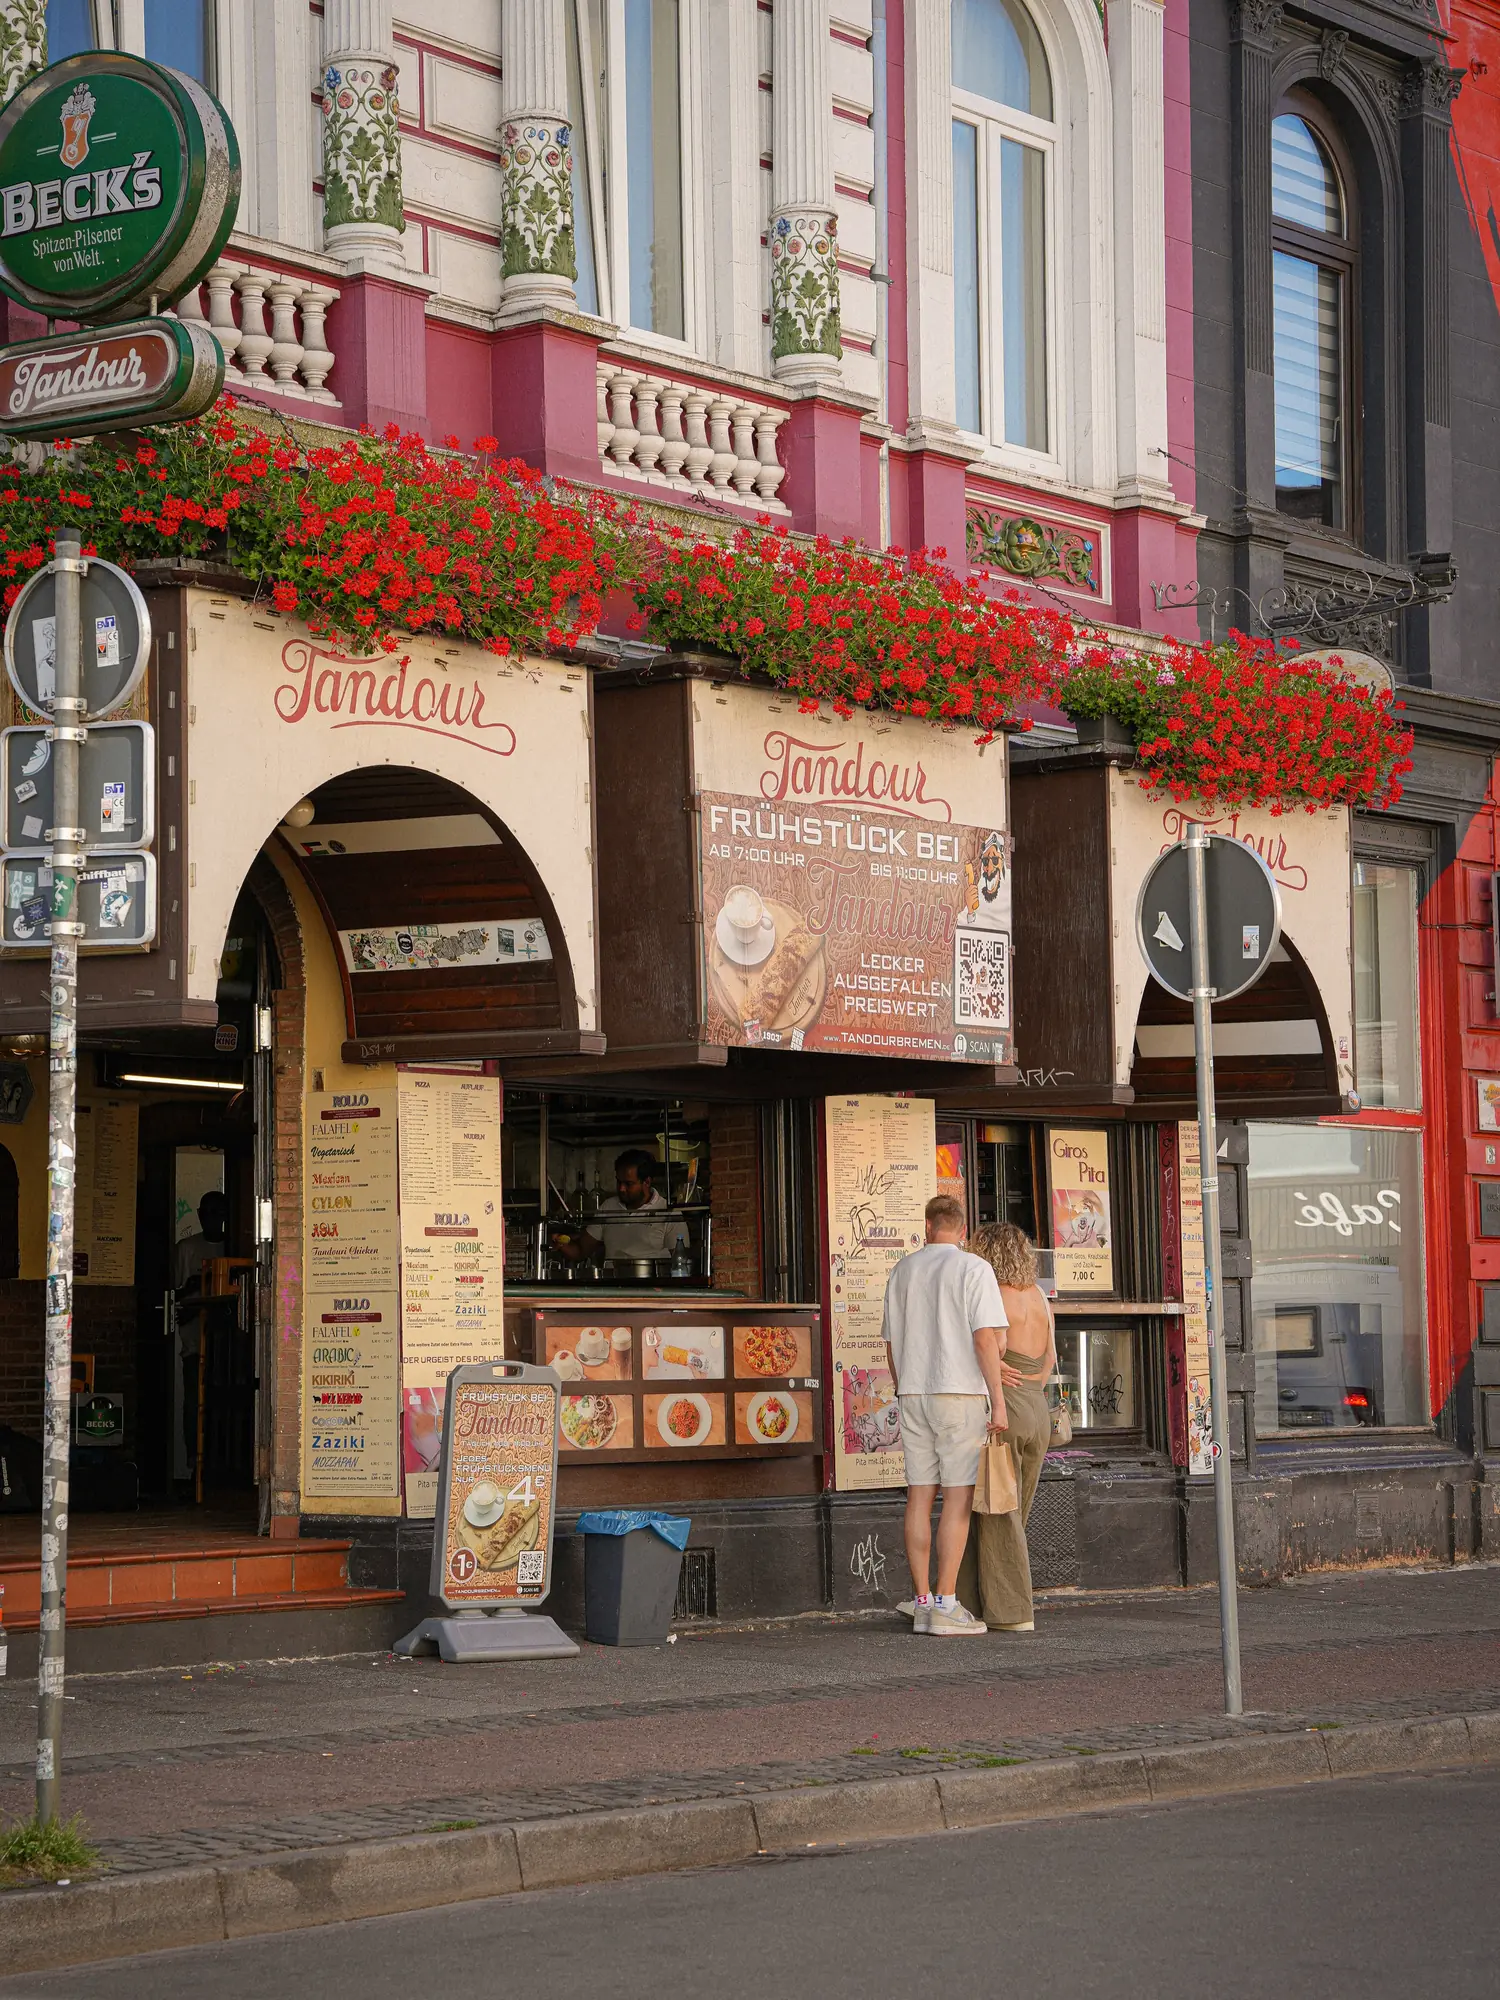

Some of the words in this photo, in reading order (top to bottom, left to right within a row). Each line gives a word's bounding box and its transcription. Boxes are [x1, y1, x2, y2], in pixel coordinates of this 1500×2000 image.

[1, 151, 162, 237] BECK'S
[33, 226, 123, 257] Spitzen-Pilsener
[9, 346, 147, 414] Tandour
[274, 639, 516, 756] Tandour
[760, 730, 952, 823] Tandour
[709, 802, 909, 857] FRÜHSTÜCK
[917, 832, 960, 863] BEI
[708, 843, 731, 859] AB
[734, 845, 770, 863] 7:00
[774, 850, 805, 868] UHR
[870, 862, 892, 879] BIS
[895, 864, 927, 882] 11:00
[931, 868, 958, 885] UHR
[805, 855, 956, 945] Tandour
[860, 952, 925, 974] LECKER
[834, 973, 952, 998] AUSGEFALLEN
[843, 995, 938, 1019] PREISWERT
[969, 1040, 990, 1053] SCAN
[332, 1094, 369, 1108] ROLLO
[312, 1122, 351, 1136] FALAFEL
[311, 1143, 355, 1160] Vegetarisch
[1053, 1137, 1089, 1160] Giros
[312, 1172, 351, 1185] Mexican
[1079, 1161, 1105, 1184] Pita
[312, 1196, 352, 1210] CYLON
[433, 1212, 470, 1226] ROLLO
[311, 1246, 347, 1257] Tandouri
[349, 1245, 379, 1256] Chicken
[454, 1241, 485, 1255] ARABIC
[1072, 1271, 1088, 1281] 7,00
[1090, 1271, 1095, 1280] €
[406, 1289, 430, 1298] CYLON
[333, 1298, 371, 1311] ROLLO
[455, 1304, 486, 1314] Zaziki
[312, 1326, 352, 1338] FALAFEL
[841, 1341, 856, 1349] DER
[313, 1347, 354, 1364] ARABIC
[403, 1356, 420, 1364] DER
[420, 1356, 454, 1364] URGEIST
[455, 1355, 471, 1363] DES
[871, 1355, 887, 1363] SEIT
[312, 1374, 355, 1386] KIKIRIKI
[530, 1393, 547, 1402] BEI
[458, 1400, 546, 1437] Tandour
[312, 1435, 365, 1449] Zaziki
[312, 1456, 360, 1468] MOZZAPAN
[456, 1455, 488, 1463] JEDES
[855, 1458, 867, 1466] Pita
